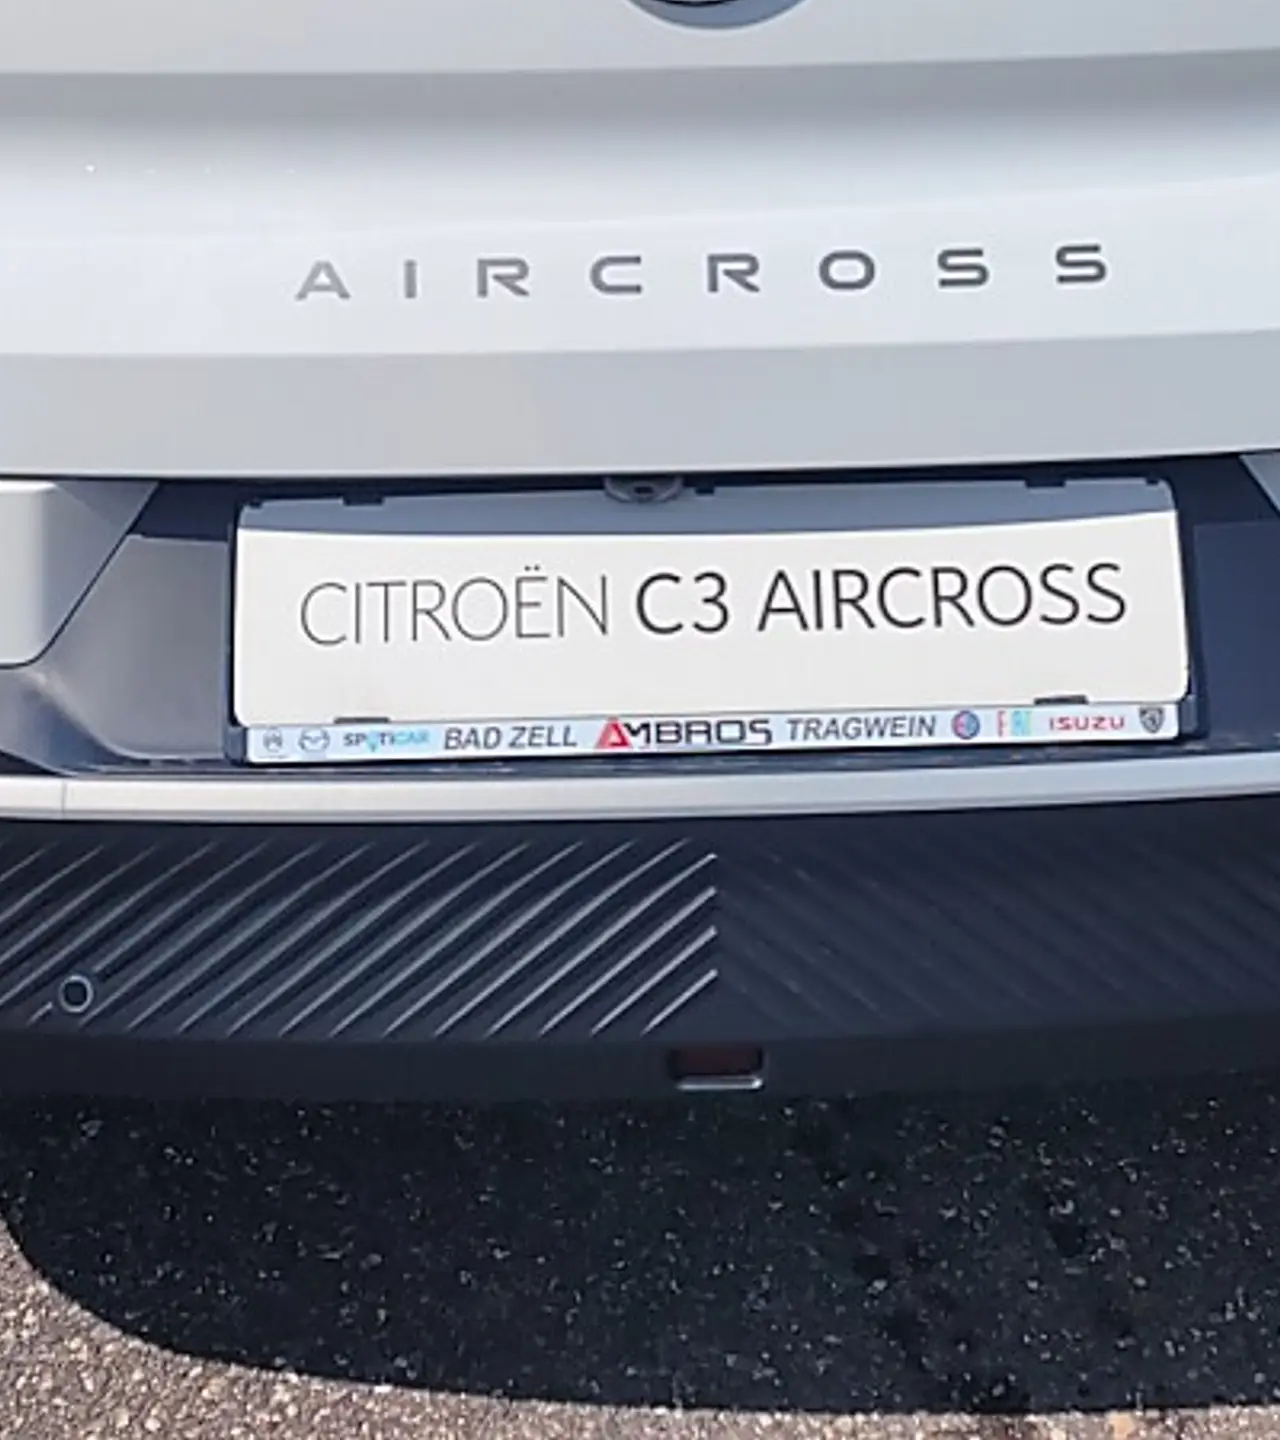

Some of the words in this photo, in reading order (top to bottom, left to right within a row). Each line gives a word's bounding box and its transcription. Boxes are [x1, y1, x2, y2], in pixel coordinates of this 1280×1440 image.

[295, 243, 1108, 301] AIRCROSS
[299, 564, 609, 646] CITROËN
[635, 571, 730, 635] C3
[757, 562, 1127, 632] AIRCROSS
[444, 723, 502, 750] BAD
[508, 724, 578, 747] ZELL
[595, 716, 771, 750] AMBROS
[787, 714, 937, 742] TRAGWEIN
[1049, 715, 1125, 732] ISUZU
